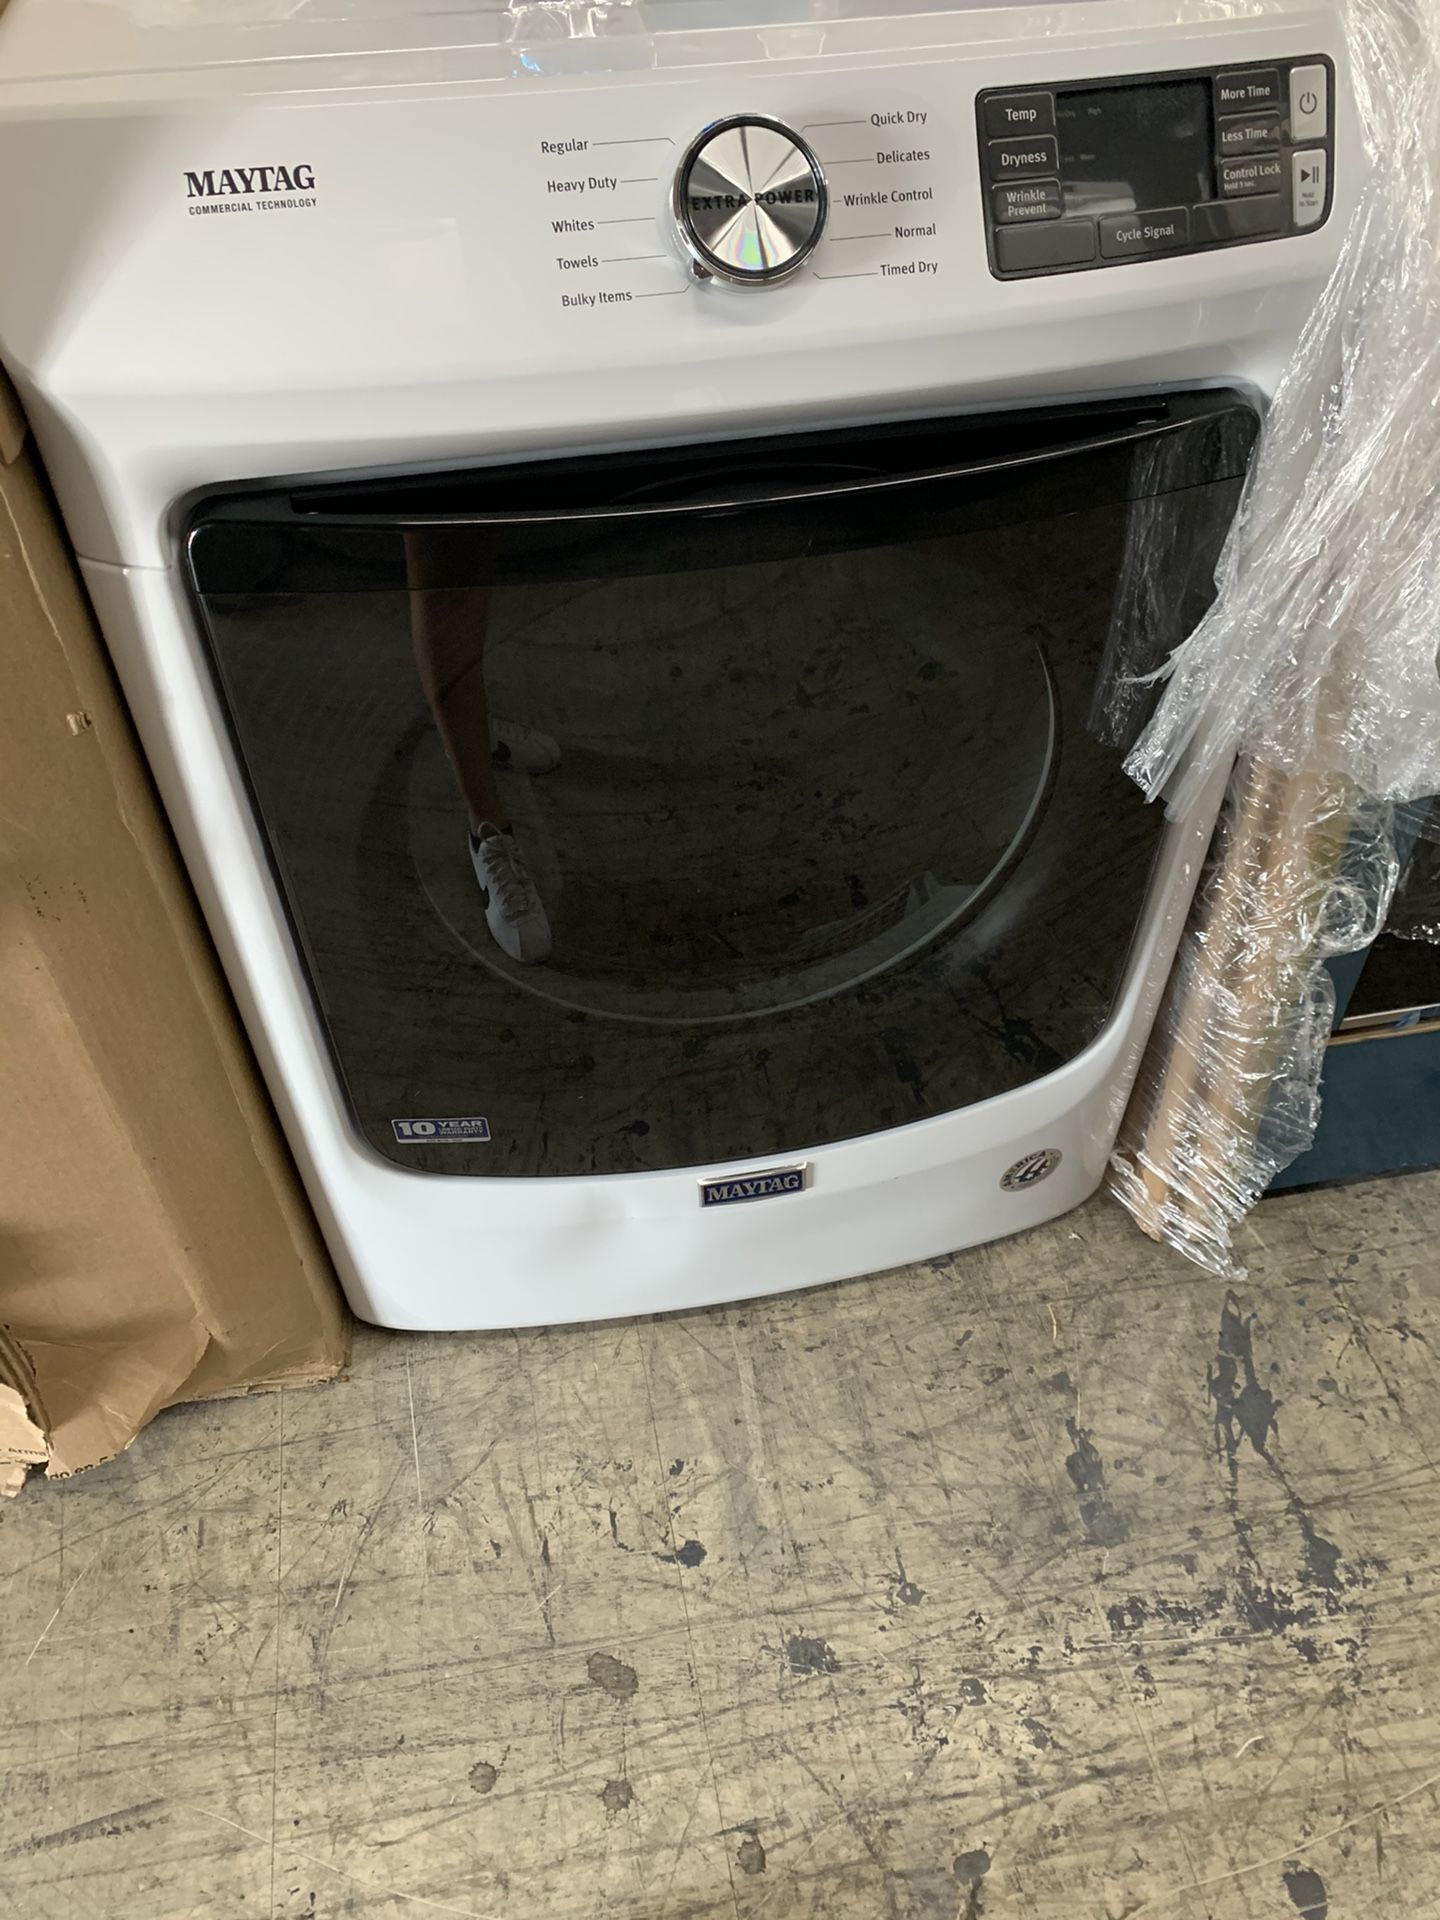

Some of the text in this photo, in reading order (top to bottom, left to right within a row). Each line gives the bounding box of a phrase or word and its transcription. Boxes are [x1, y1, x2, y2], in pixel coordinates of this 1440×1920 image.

[1221, 85, 1271, 101] More Time
[870, 110, 927, 127] Quick Dry
[1005, 108, 1037, 122] Temp
[1221, 127, 1268, 142] Less Time
[541, 138, 589, 156] Regular
[876, 149, 931, 164] Delicates
[1001, 151, 1048, 168] Dryness
[1223, 162, 1282, 181] Control Lock
[183, 164, 316, 198] MAYTAG
[547, 177, 617, 194] Heavy Duty
[691, 189, 815, 211] EXTRA POWER
[843, 187, 933, 207] Wrinkle Control
[1006, 189, 1047, 203] Wrinkle
[188, 198, 318, 216] COMMERCIAL TECHNOLOGY
[1007, 203, 1047, 217] Prevent
[551, 219, 595, 233] Whites
[894, 222, 937, 238] Normal
[1116, 224, 1175, 244] Cycle Signal
[556, 255, 599, 270] Towels
[879, 260, 939, 277] Timed Dry
[561, 291, 633, 308] Bulky Items
[398, 1122, 437, 1136] 10
[438, 1120, 483, 1128] YEAR
[706, 1174, 800, 1202] MAYTAG
